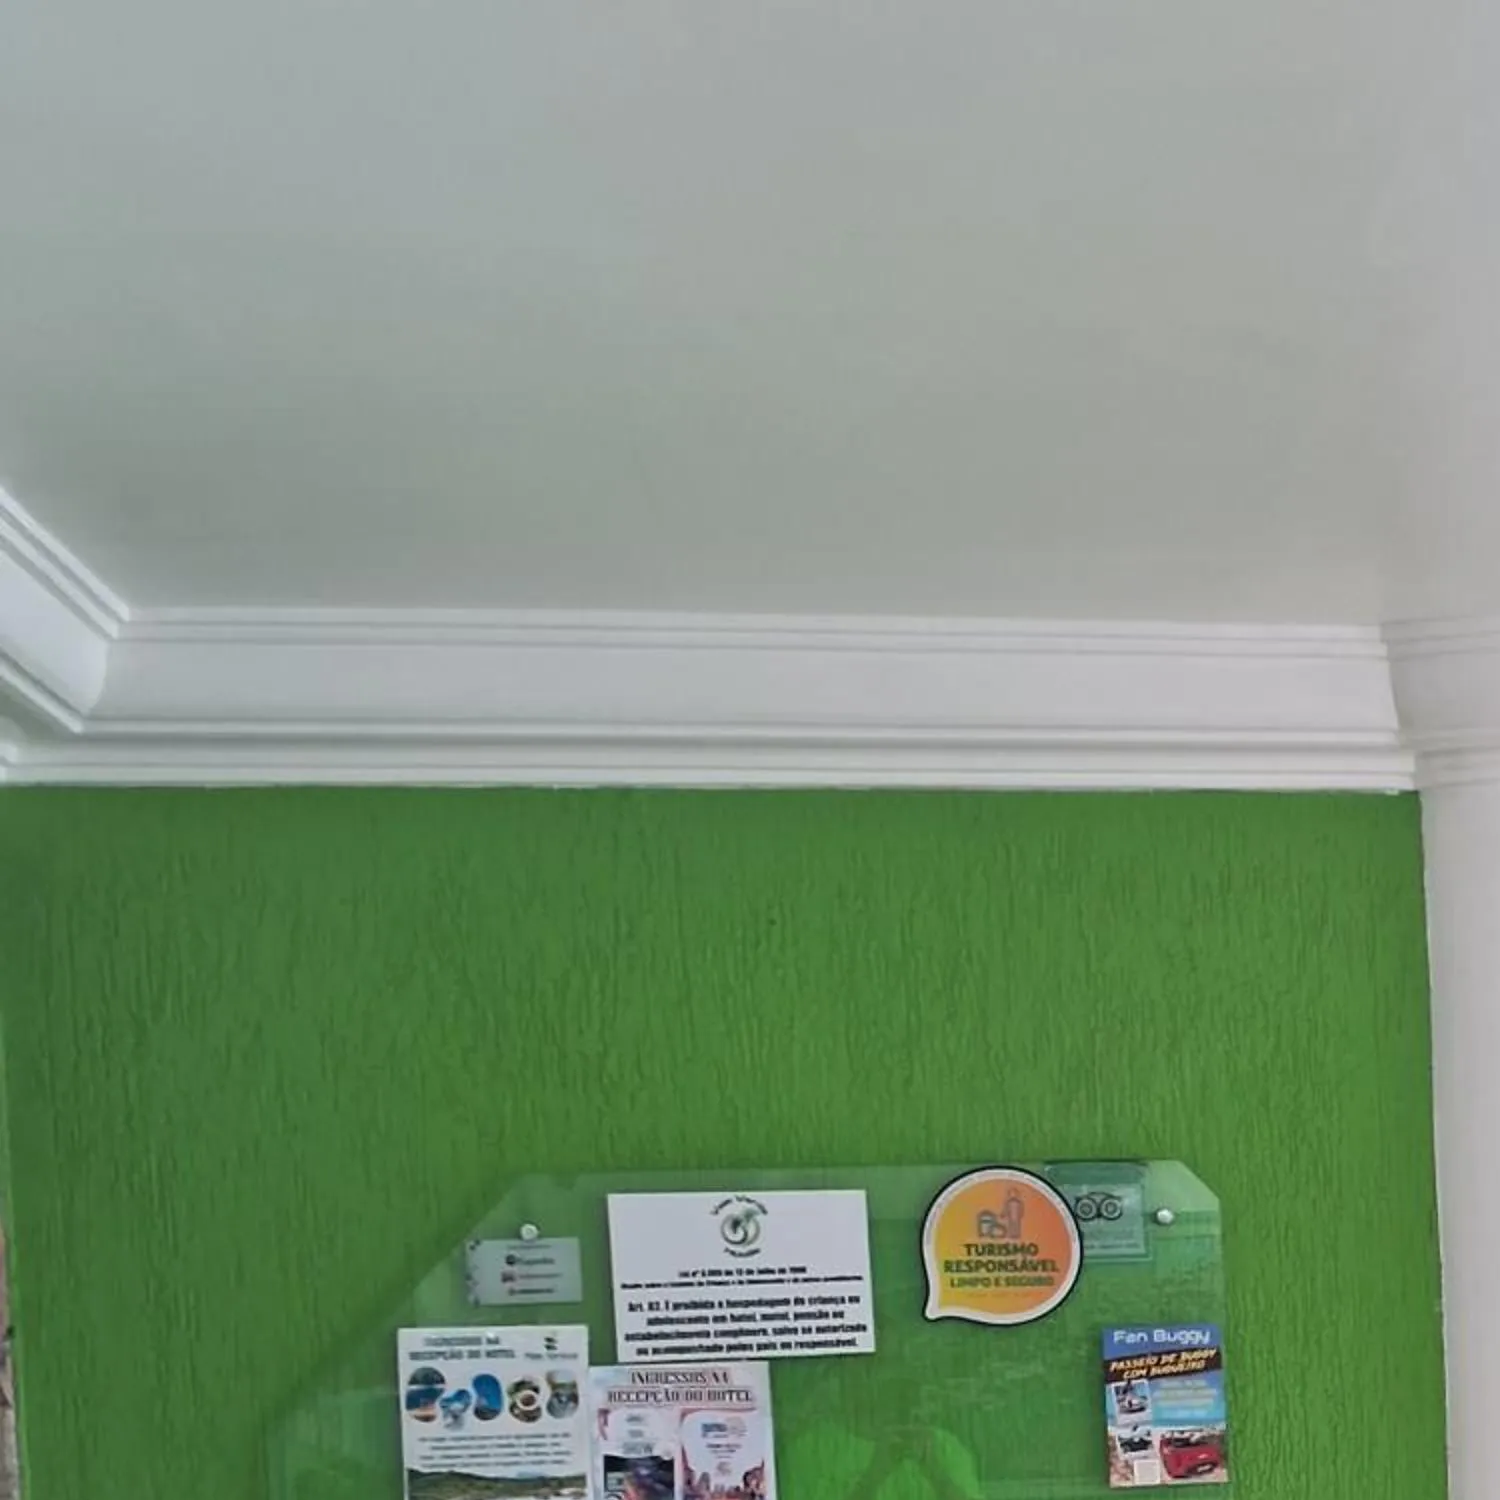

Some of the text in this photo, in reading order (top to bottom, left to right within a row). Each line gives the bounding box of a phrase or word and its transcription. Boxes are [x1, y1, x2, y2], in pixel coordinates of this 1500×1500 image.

[963, 1243, 1039, 1256] TURISMO
[944, 1255, 1059, 1273] RESPONSÁVEL
[950, 1275, 991, 1288] LIMPO
[1005, 1276, 1054, 1287] SEGURO
[808, 1296, 845, 1308] criança
[1113, 1329, 1211, 1345] Fan Buggy
[607, 1388, 680, 1403] RECEPÇÃO
[708, 1389, 752, 1402] HOTEL
